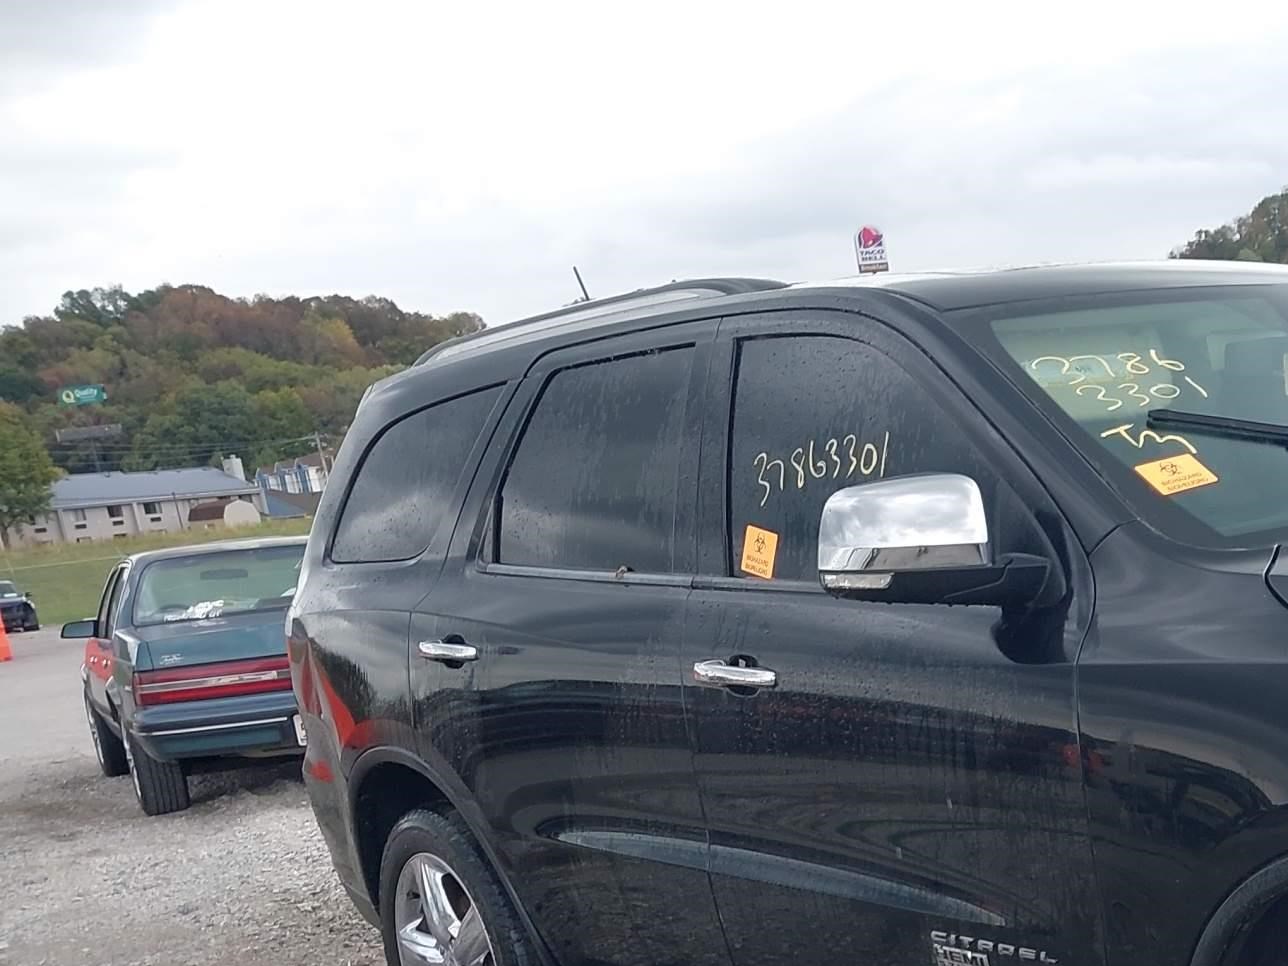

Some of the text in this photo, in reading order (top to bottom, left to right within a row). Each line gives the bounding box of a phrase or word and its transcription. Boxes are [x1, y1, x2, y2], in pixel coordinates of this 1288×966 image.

[859, 248, 885, 257] TACO
[753, 431, 890, 508] 37863301
[930, 930, 1059, 964] CITADEL
